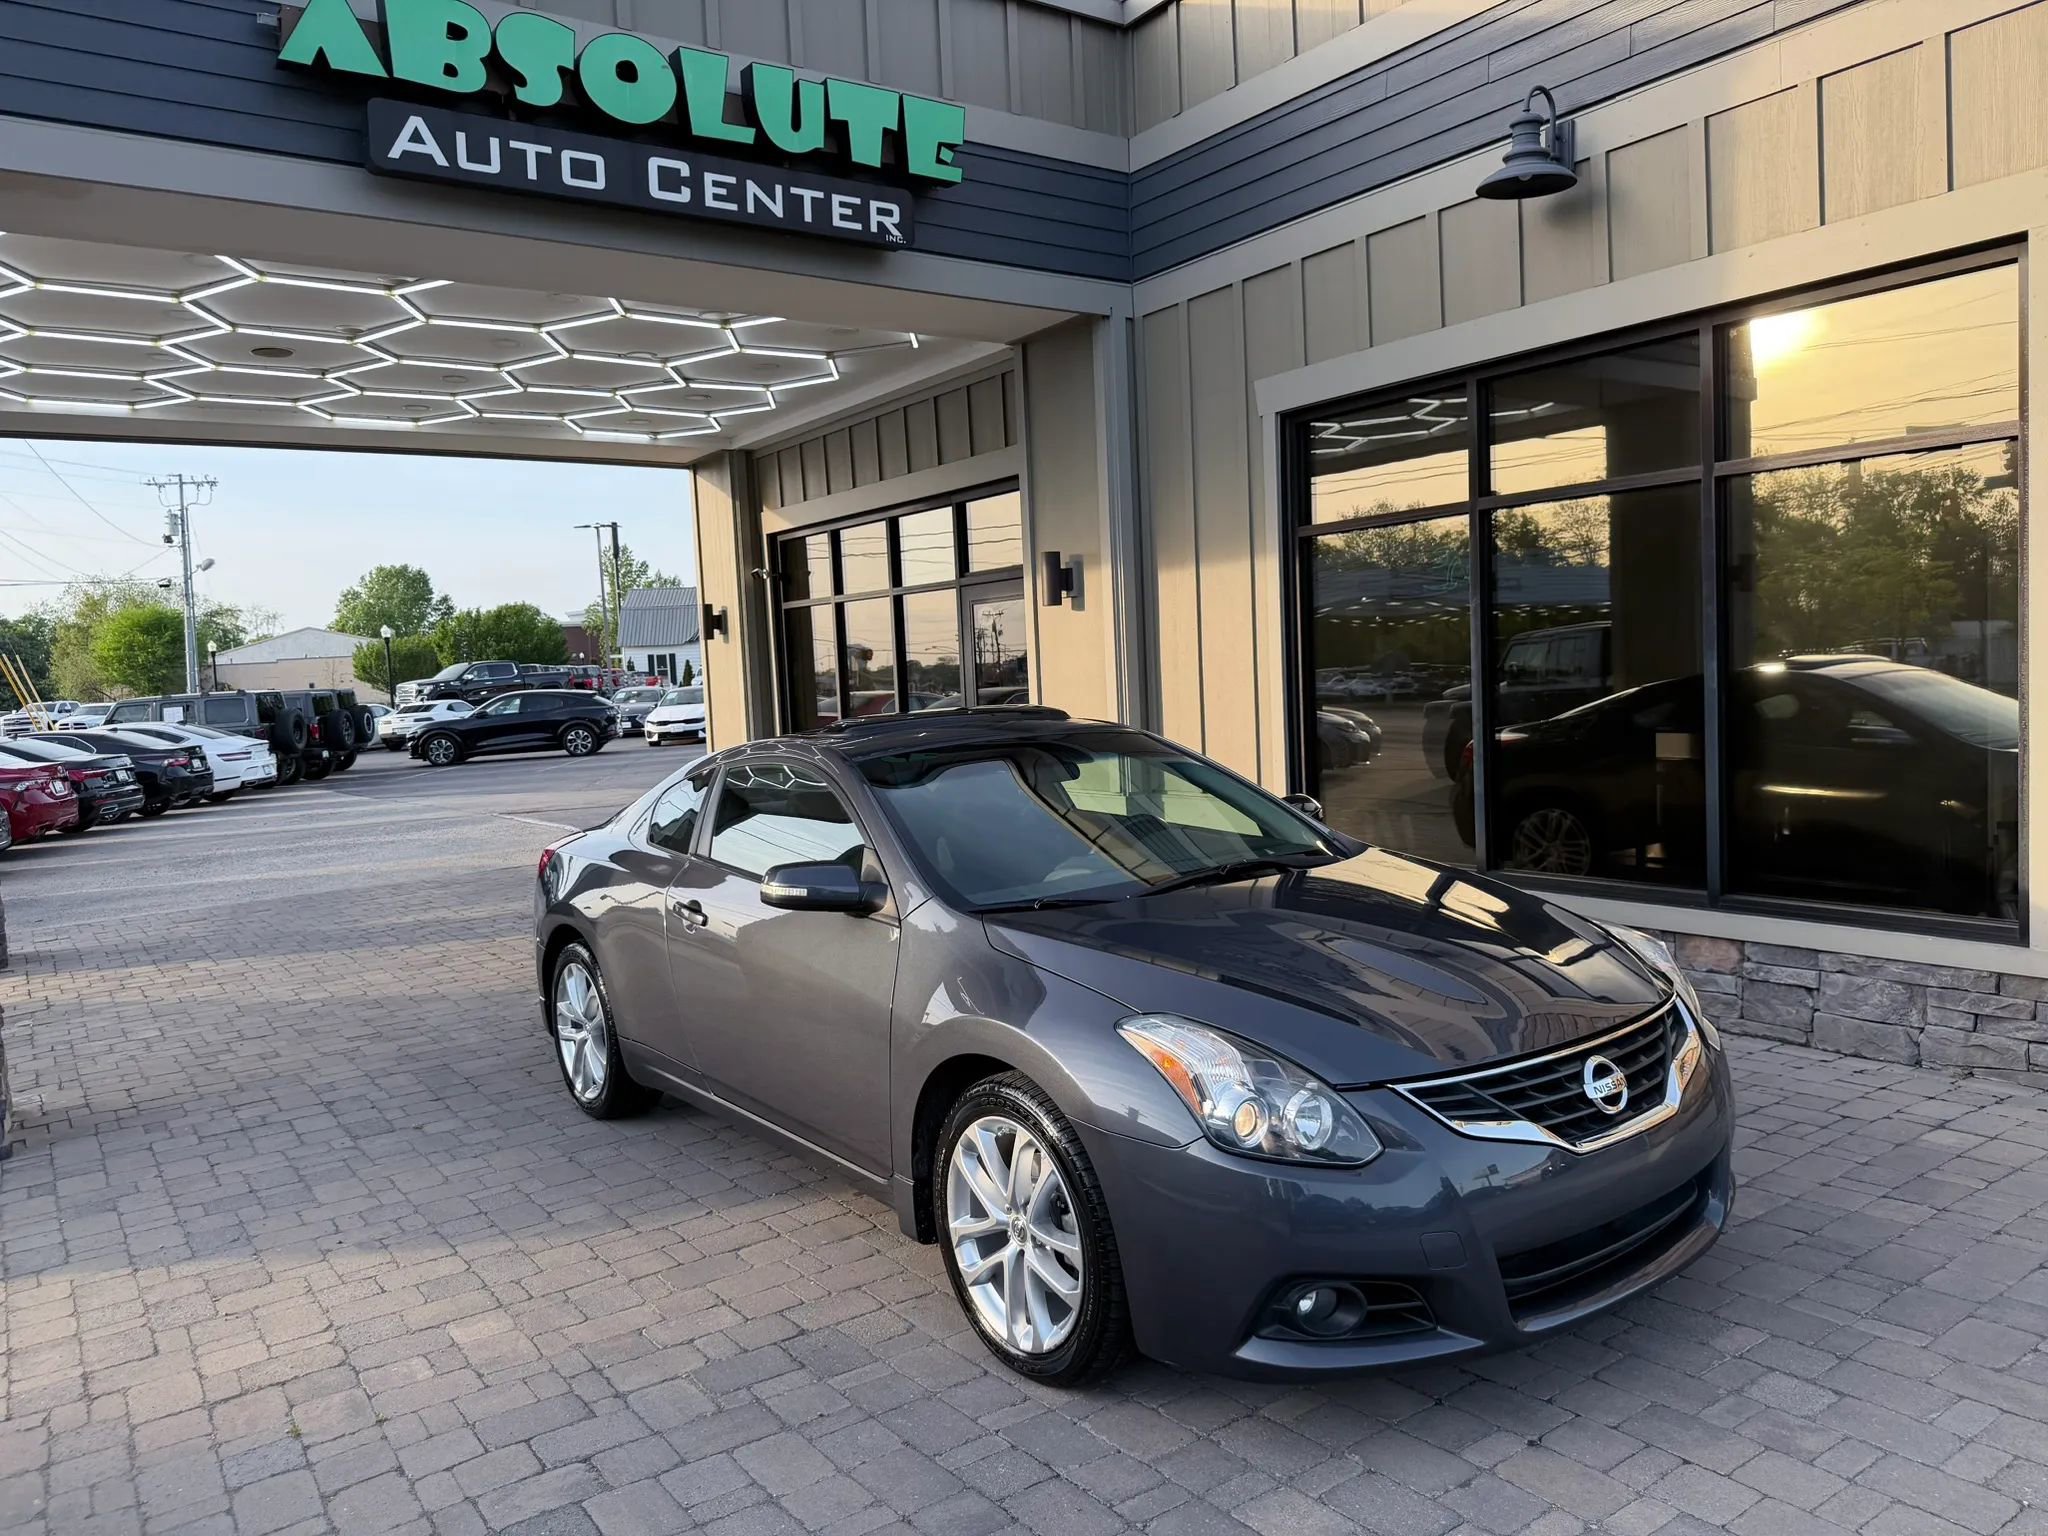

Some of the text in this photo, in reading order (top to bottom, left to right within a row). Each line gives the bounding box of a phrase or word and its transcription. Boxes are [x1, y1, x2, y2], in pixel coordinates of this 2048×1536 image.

[277, 0, 966, 183] ABSOLUTE
[386, 114, 902, 236] AUTO CENTER
[885, 234, 907, 244] INC.
